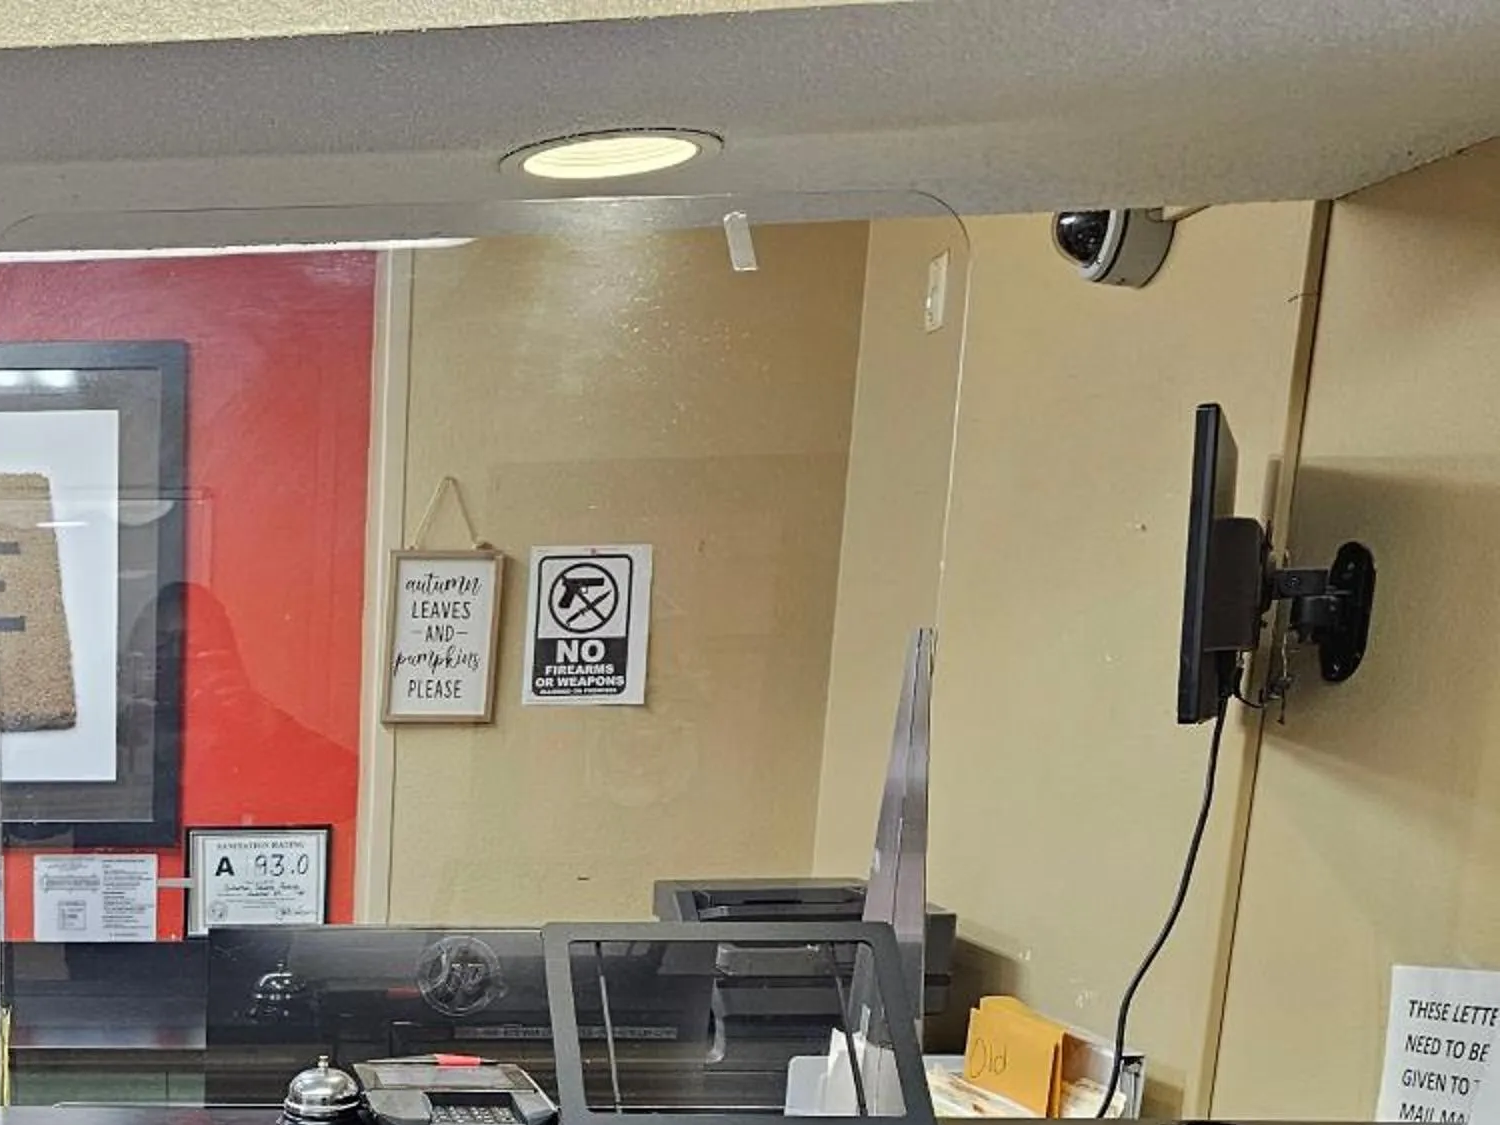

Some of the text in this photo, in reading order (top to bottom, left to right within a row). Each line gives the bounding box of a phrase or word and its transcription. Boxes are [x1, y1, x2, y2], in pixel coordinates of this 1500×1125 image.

[405, 573, 482, 596] autumn
[411, 601, 472, 619] LEAVES
[425, 625, 455, 643] AND
[393, 645, 481, 677] pumpkins
[556, 639, 605, 663] NO
[545, 663, 614, 675] FIREARMS
[407, 679, 463, 699] PLEASE
[535, 675, 625, 687] OR WEAPONS
[215, 853, 309, 877] A 93.0
[1409, 999, 1451, 1021] THESE
[970, 1038, 1007, 1078] Old
[1405, 1034, 1491, 1062] NEED TO BE
[1402, 1069, 1470, 1095] GIVEN TO
